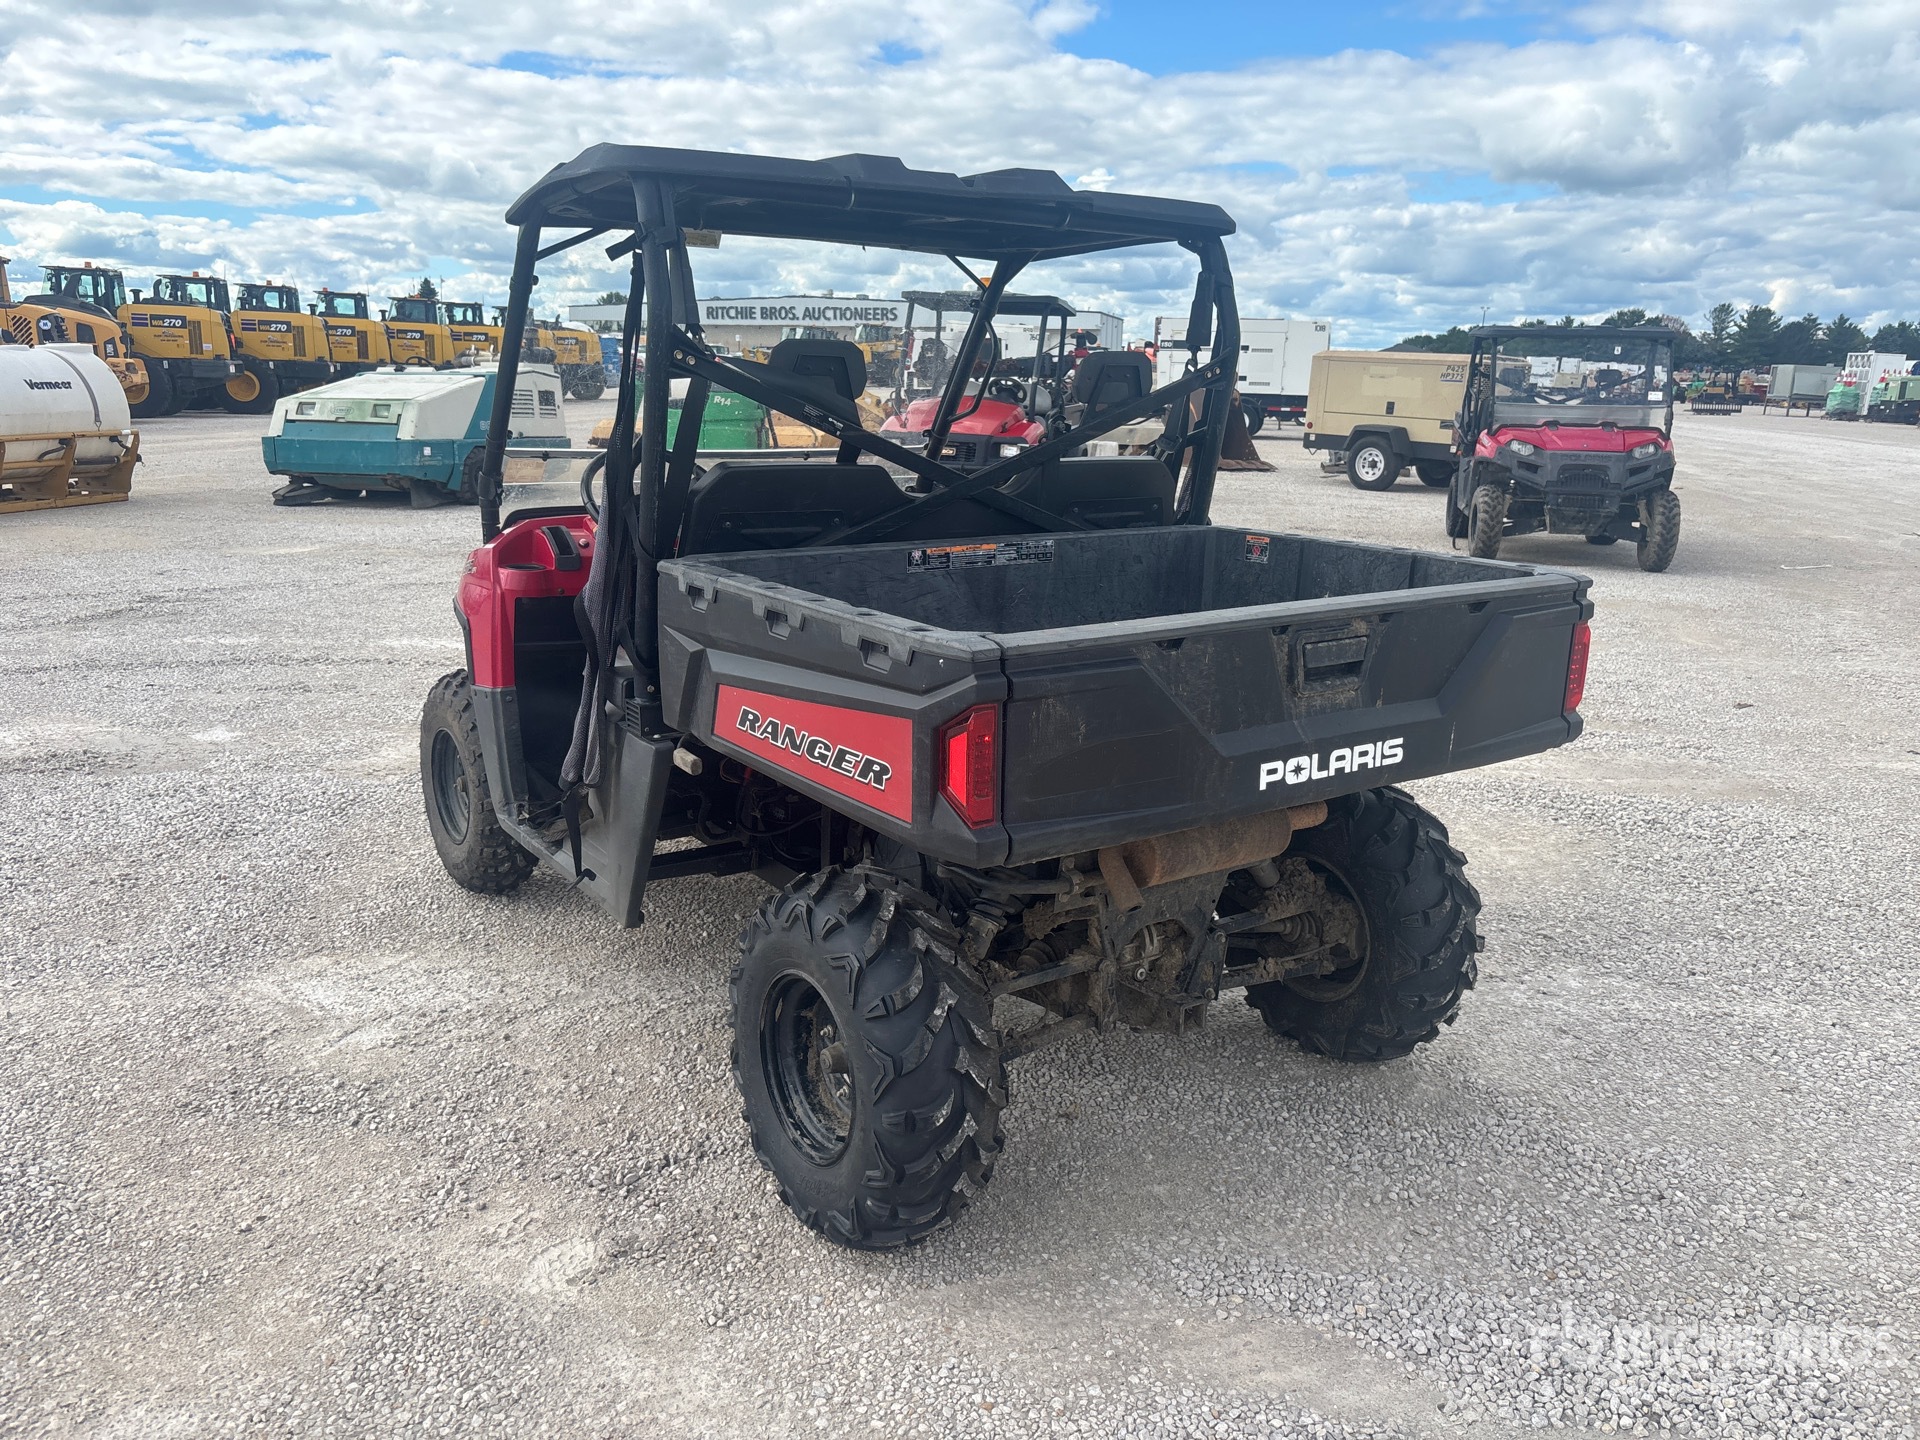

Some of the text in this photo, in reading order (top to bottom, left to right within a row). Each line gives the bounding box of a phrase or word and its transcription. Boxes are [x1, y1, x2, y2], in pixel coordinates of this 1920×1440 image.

[706, 305, 899, 322] RITCHIE BROS. AUCTIONEERS
[151, 318, 182, 327] WA270
[259, 323, 288, 331] WA270
[1446, 365, 1465, 373] P425
[1440, 372, 1464, 380] HP375
[23, 379, 72, 390] Vermeer
[713, 395, 731, 406] R14
[736, 705, 892, 790] RANGER
[1259, 737, 1404, 791] POLARIS
